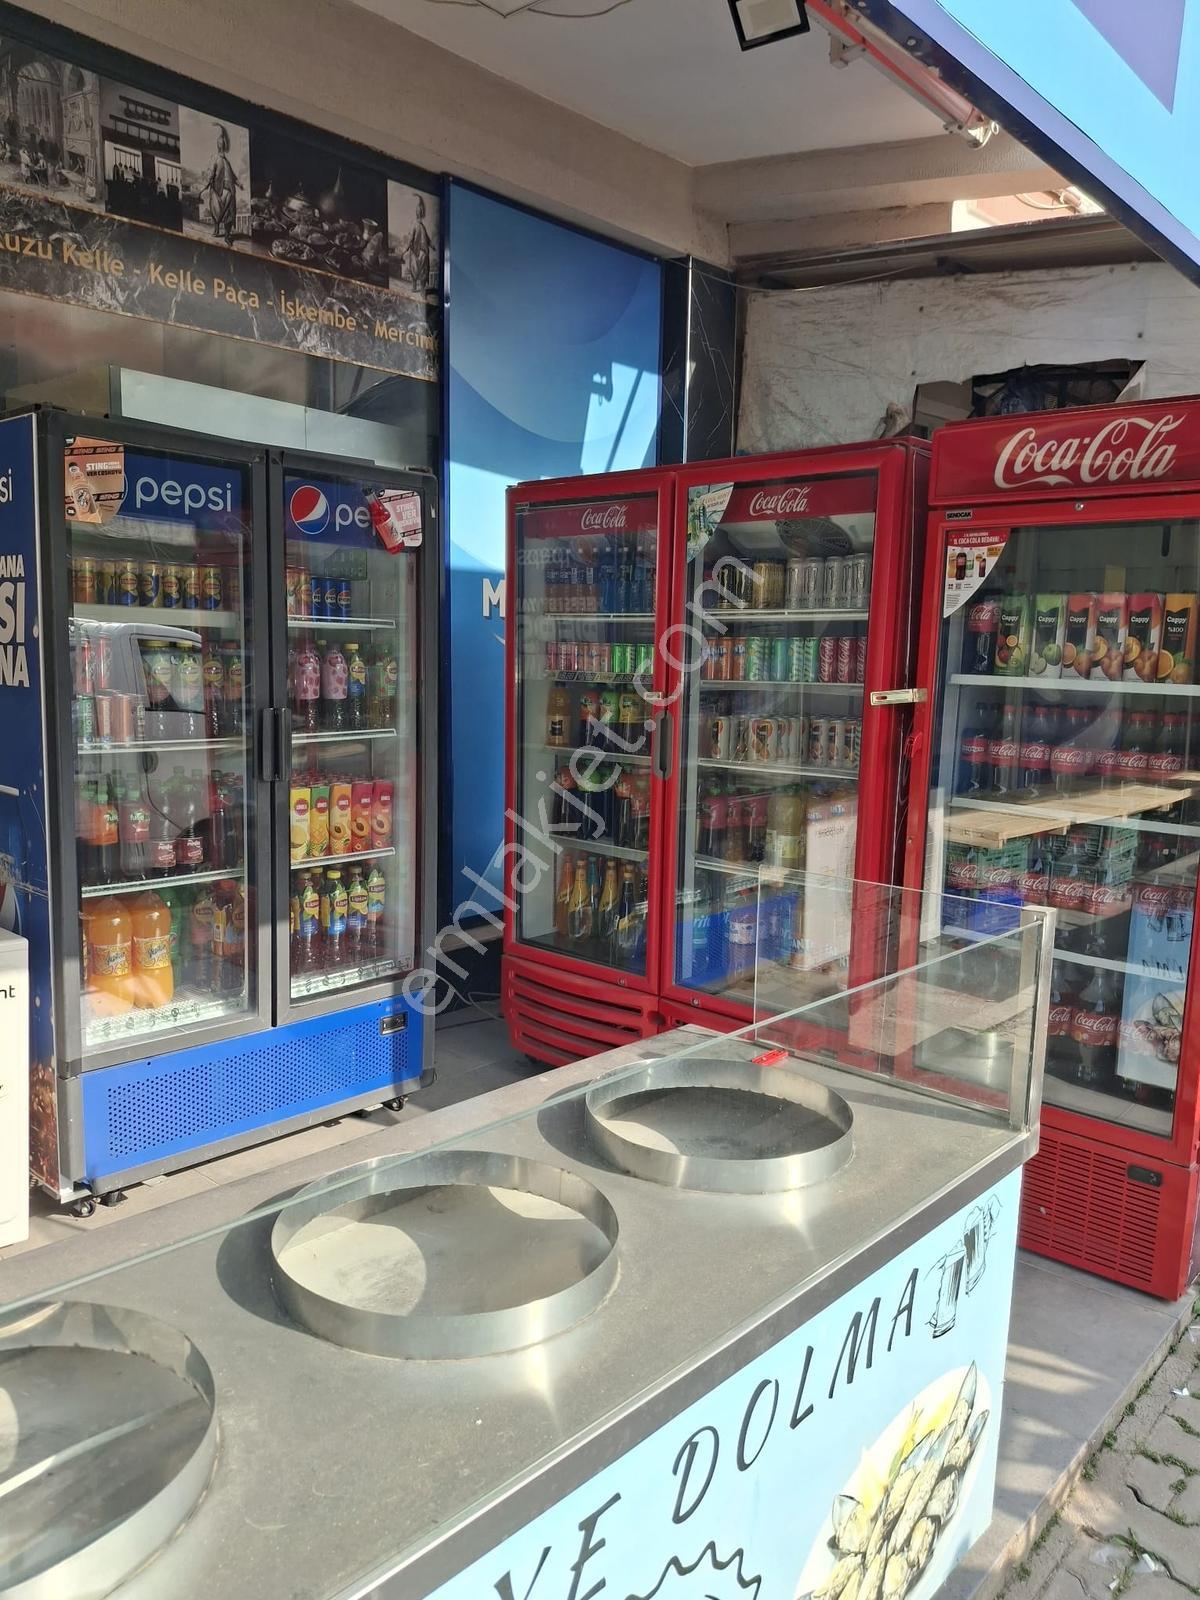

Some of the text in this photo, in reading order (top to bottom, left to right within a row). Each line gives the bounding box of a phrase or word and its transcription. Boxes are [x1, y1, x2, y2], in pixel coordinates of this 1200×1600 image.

[63, 242, 125, 276] Kelle
[150, 263, 206, 296] Kelle
[213, 278, 259, 311] Paça
[280, 290, 357, 331] İşkembe
[136, 476, 233, 515] pepsi
[1001, 614, 1018, 623] Cappy
[1038, 615, 1056, 624] Cappy
[1069, 615, 1087, 624] Cappy
[1099, 615, 1118, 624] Cappy
[1130, 615, 1149, 624] Cappy
[1166, 615, 1187, 625] Cappy
[672, 1267, 919, 1526] DOLMA
